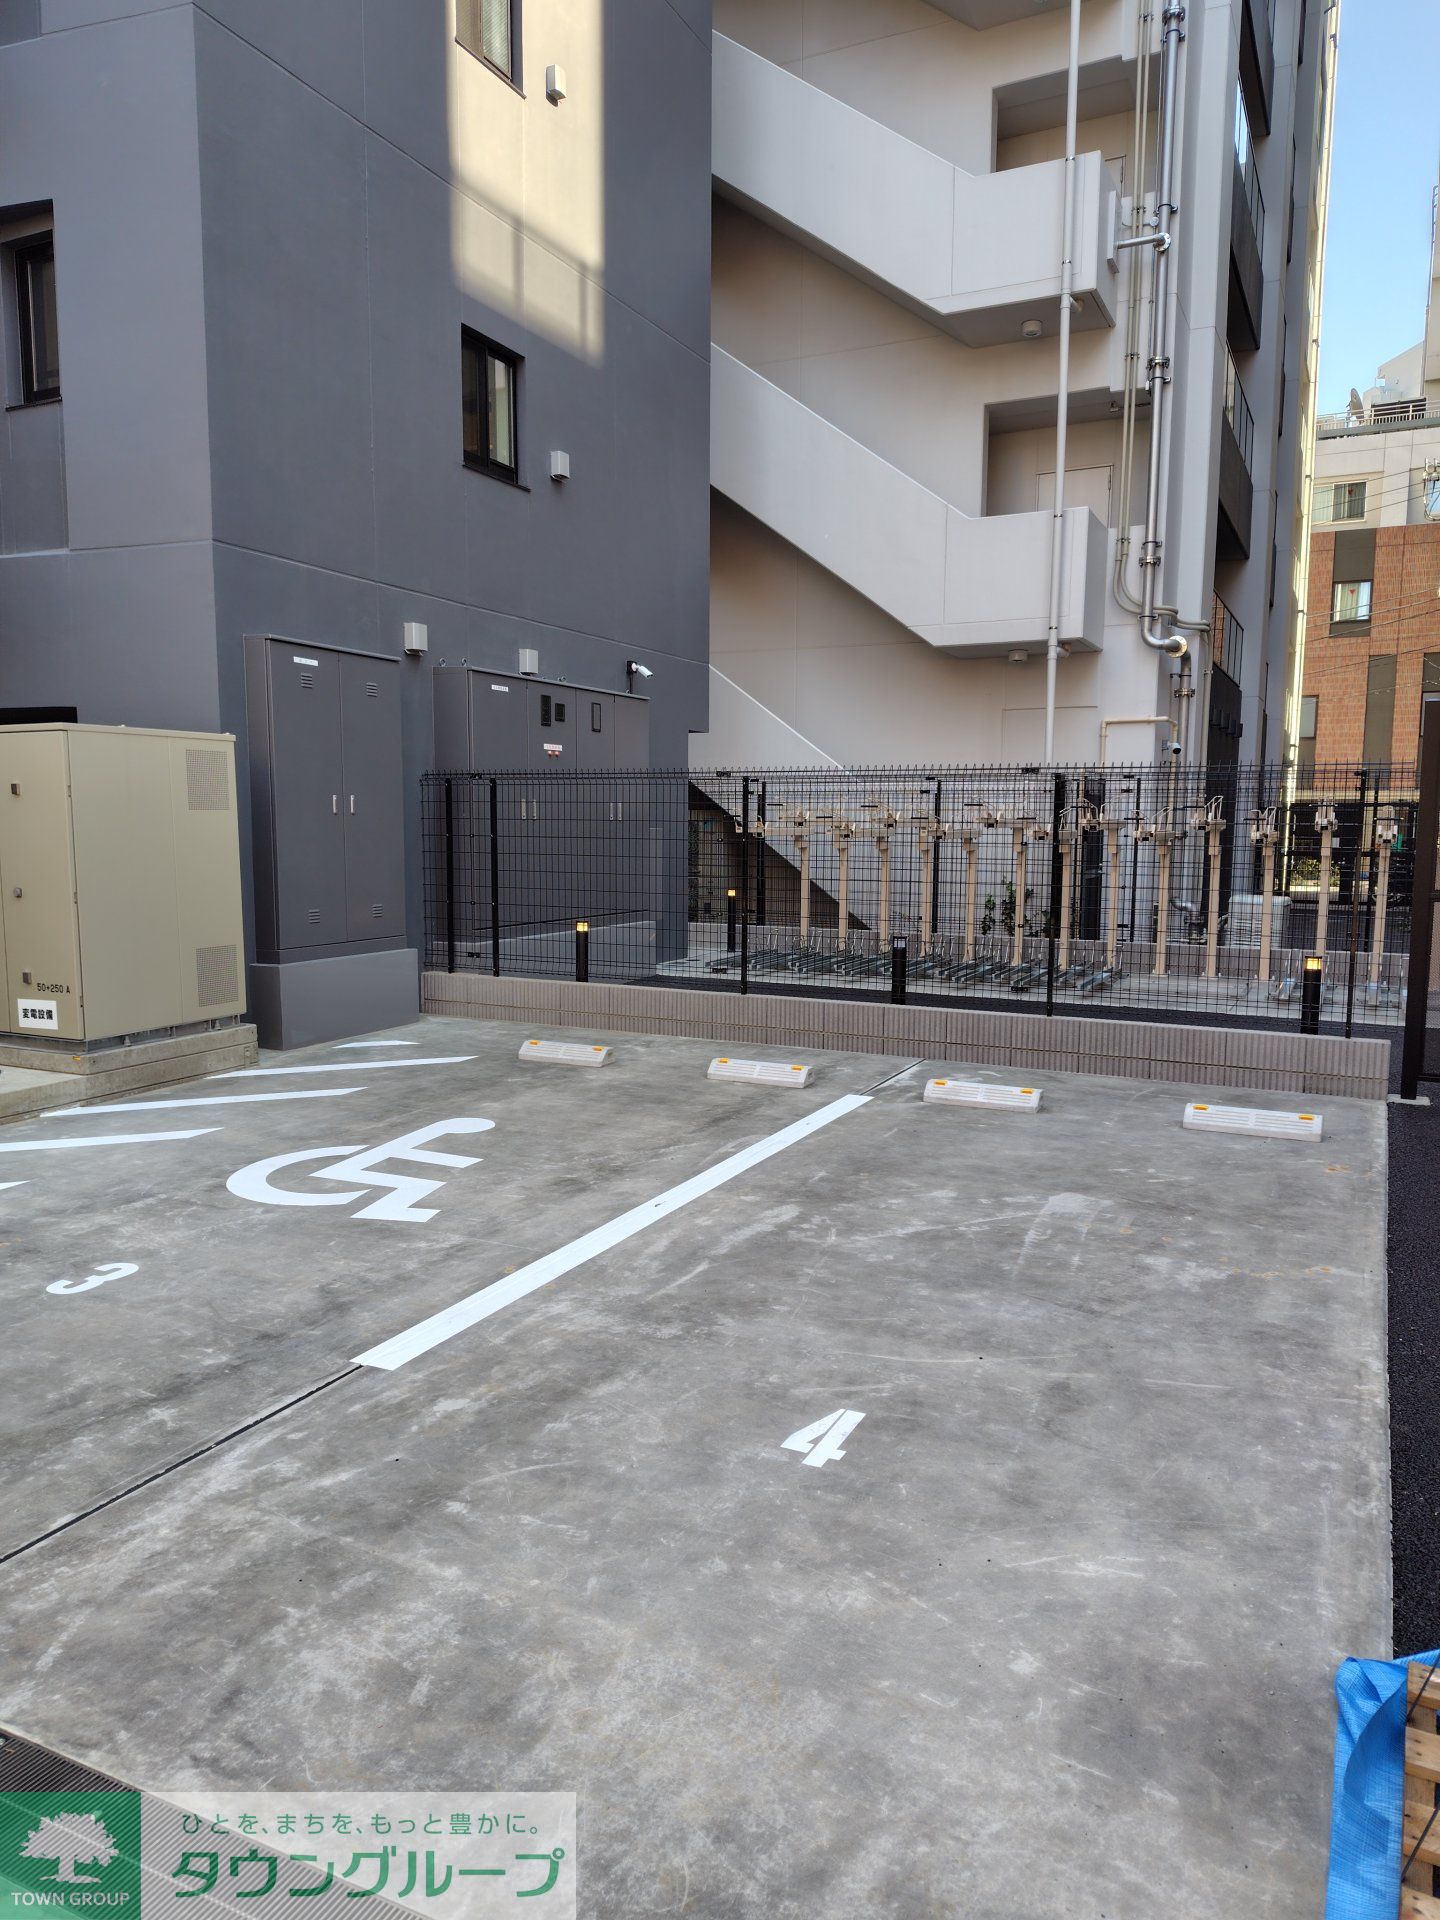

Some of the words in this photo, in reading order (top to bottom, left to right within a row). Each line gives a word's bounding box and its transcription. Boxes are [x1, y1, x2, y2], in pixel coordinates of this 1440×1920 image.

[66, 985, 71, 994] A
[22, 1008, 54, 1020] 変電設備
[46, 1262, 140, 1295] 3
[780, 1408, 867, 1468] 4
